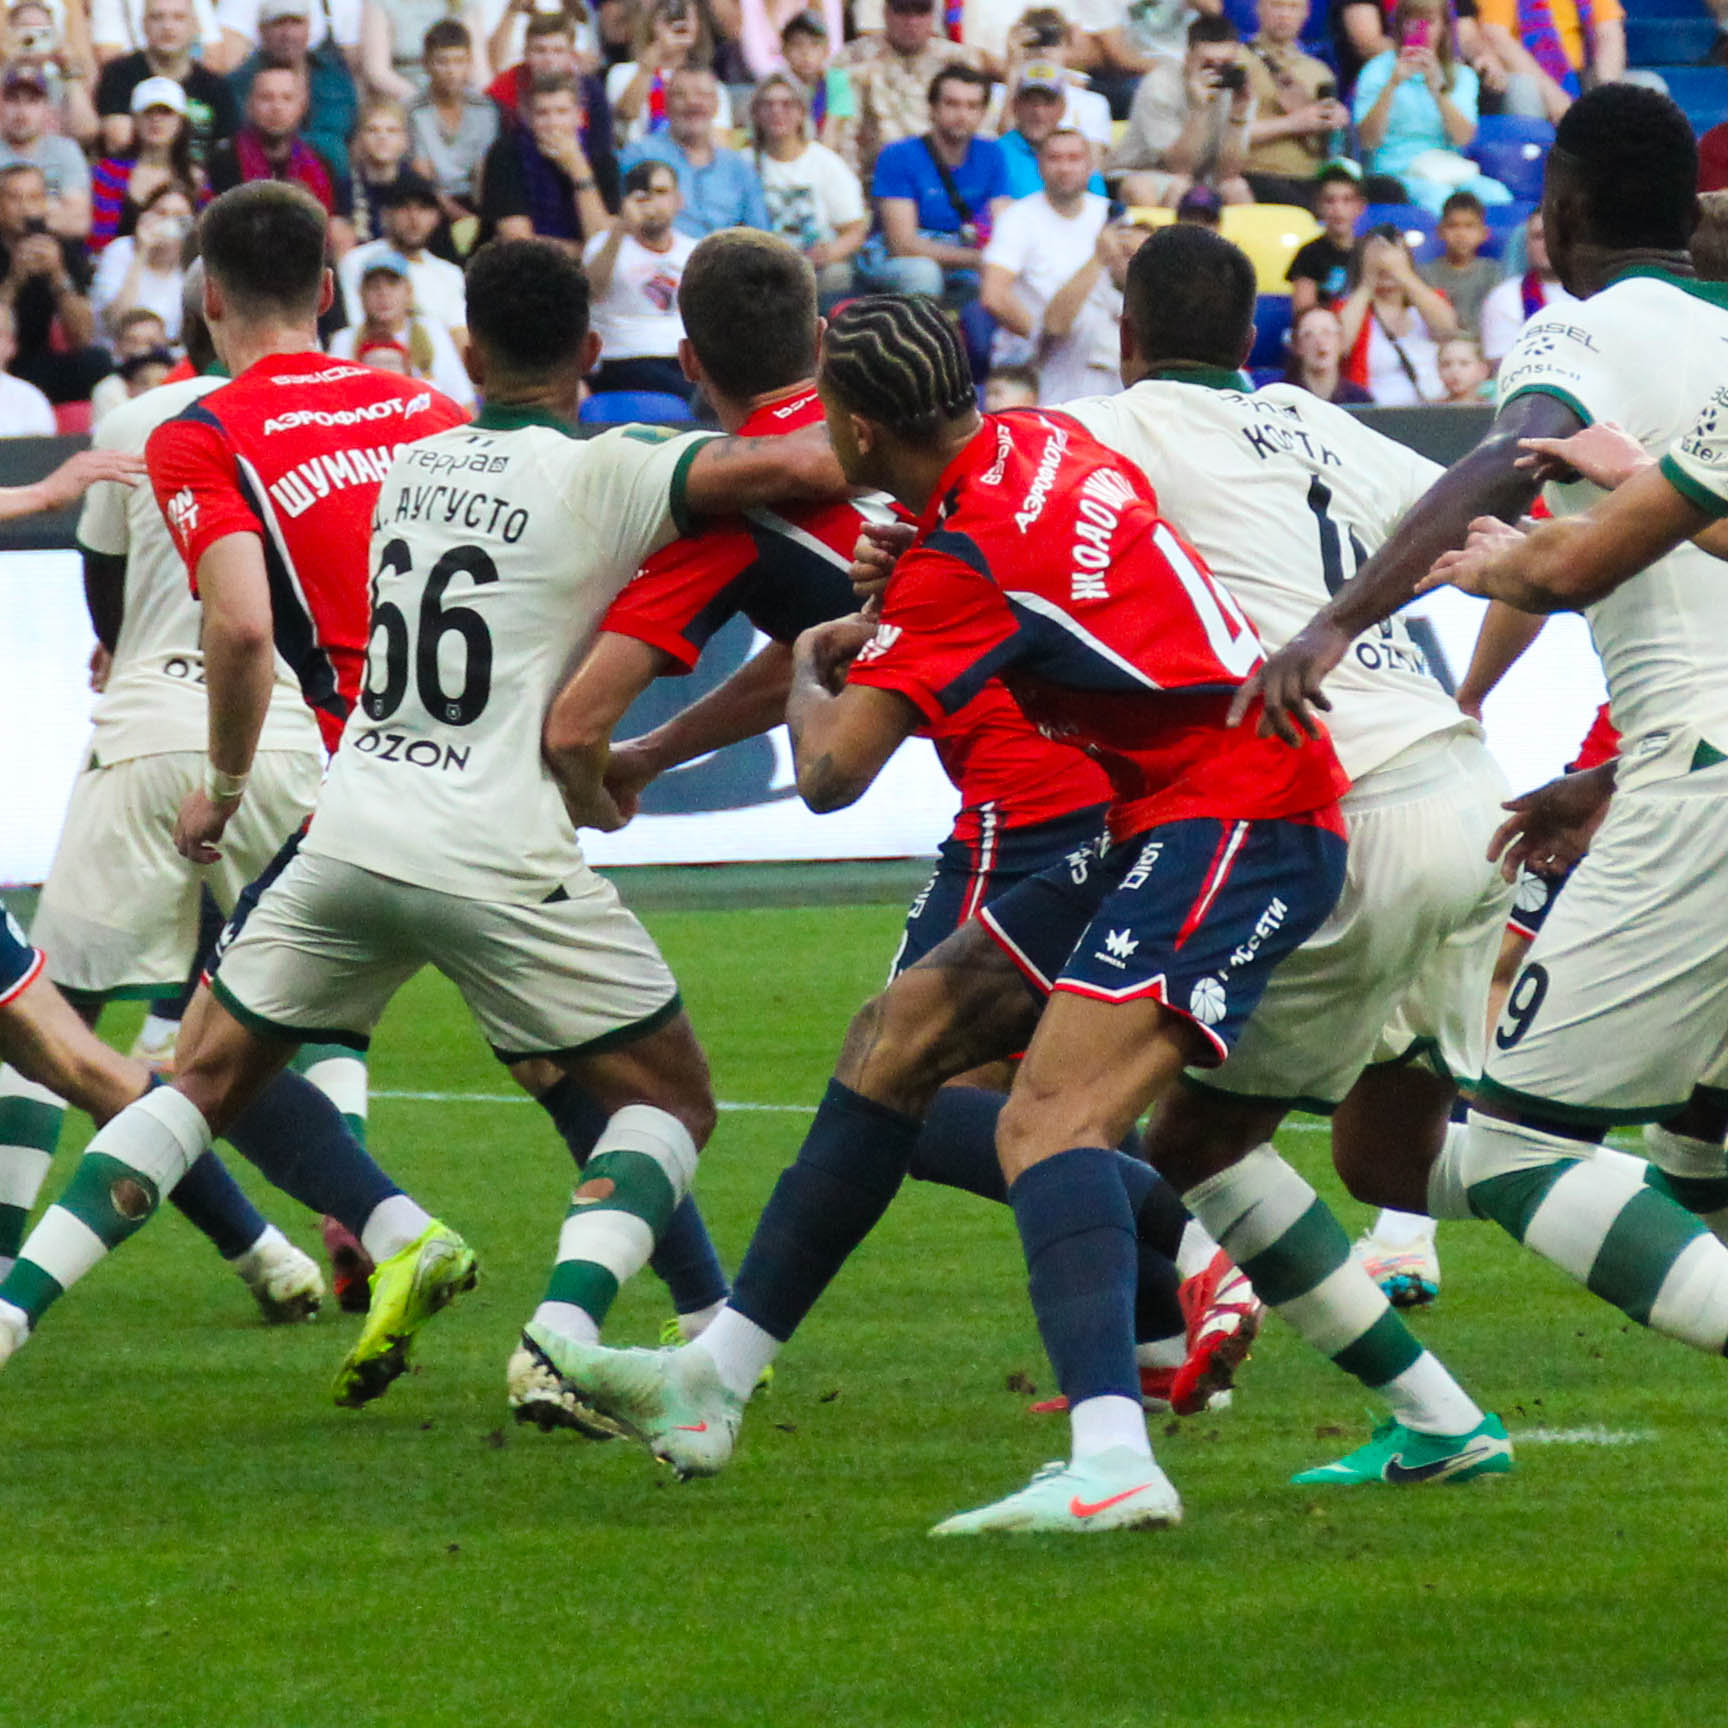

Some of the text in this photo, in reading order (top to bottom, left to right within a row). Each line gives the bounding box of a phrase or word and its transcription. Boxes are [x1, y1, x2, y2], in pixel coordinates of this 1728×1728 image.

[264, 397, 406, 437] АЭРОФЛОТ
[395, 484, 530, 544] АУГУСТО
[361, 538, 500, 727] 66
[353, 728, 473, 772] OZON
[1495, 962, 1550, 1051] 9
